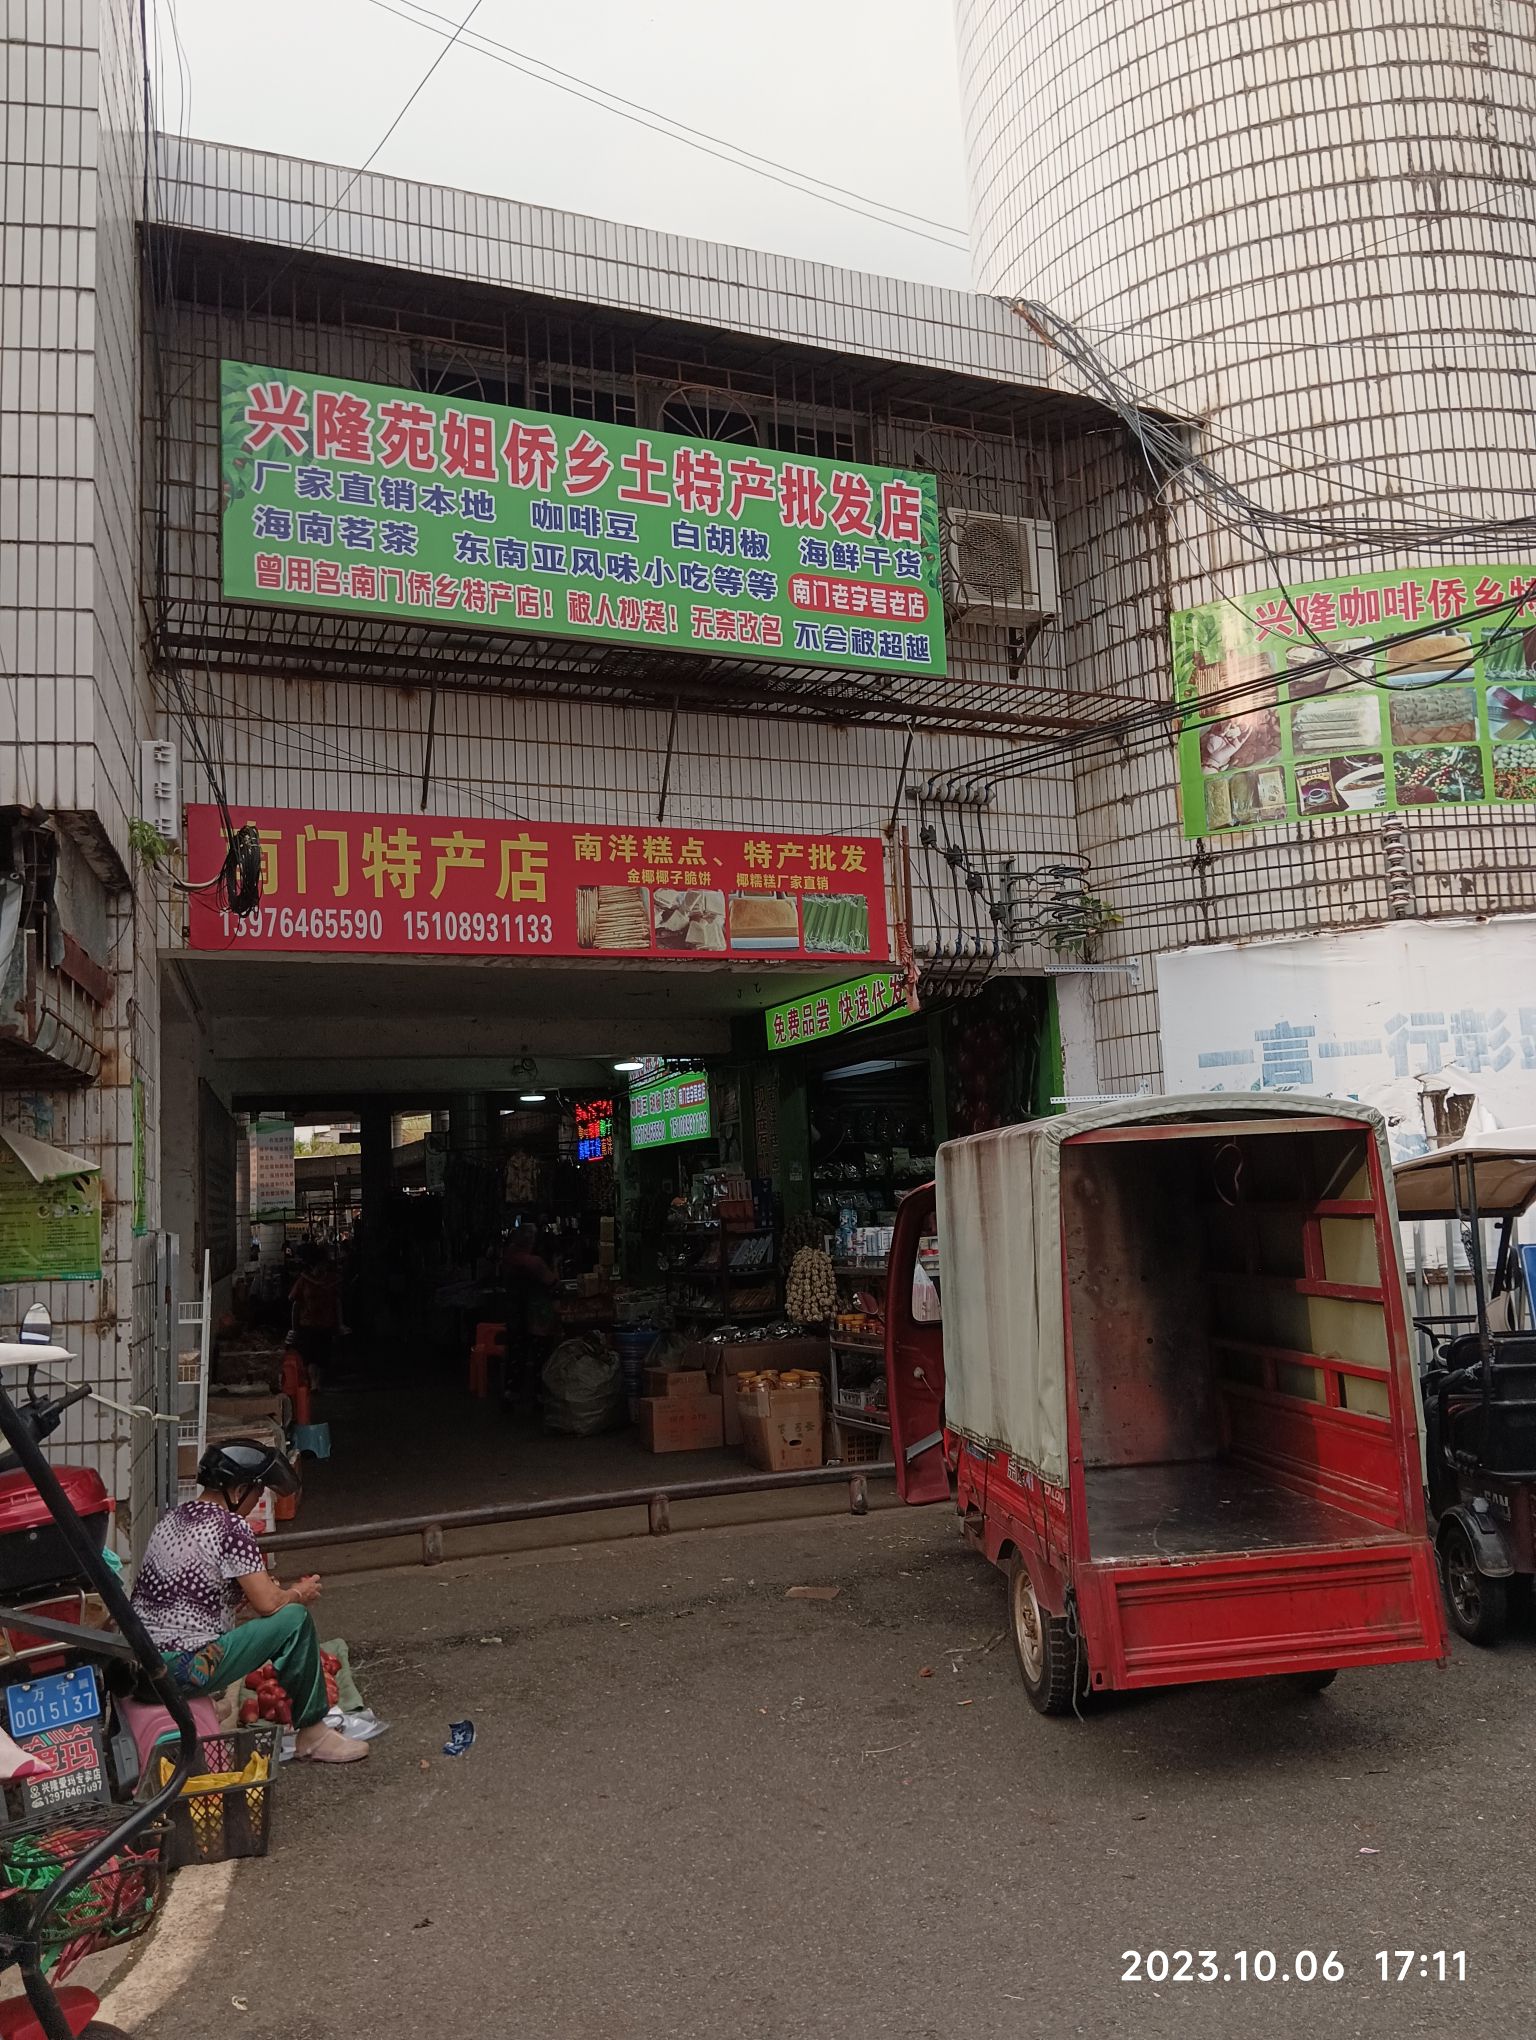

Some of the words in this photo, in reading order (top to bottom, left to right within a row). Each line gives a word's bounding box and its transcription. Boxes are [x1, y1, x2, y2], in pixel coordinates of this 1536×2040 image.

[246, 382, 923, 543] 兴隆苑姐侨乡土特产批发店
[253, 462, 496, 522] 厂家直销本地
[532, 501, 638, 543] 咖啡豆
[671, 521, 770, 560] 白胡椒
[799, 538, 923, 580] 海鲜干货
[253, 506, 418, 556] 海南茗茶
[453, 532, 778, 601] 东南亚风味小吃等等
[791, 579, 926, 619] 南门老字号老店
[793, 621, 932, 664] 不会被超越
[220, 906, 384, 940] 13976465590
[403, 911, 553, 944] 15108931133
[773, 998, 831, 1045] 免费品尝
[15, 1692, 94, 1729] 0015137
[41, 1768, 102, 1794] 兴隆爱玛专卖店
